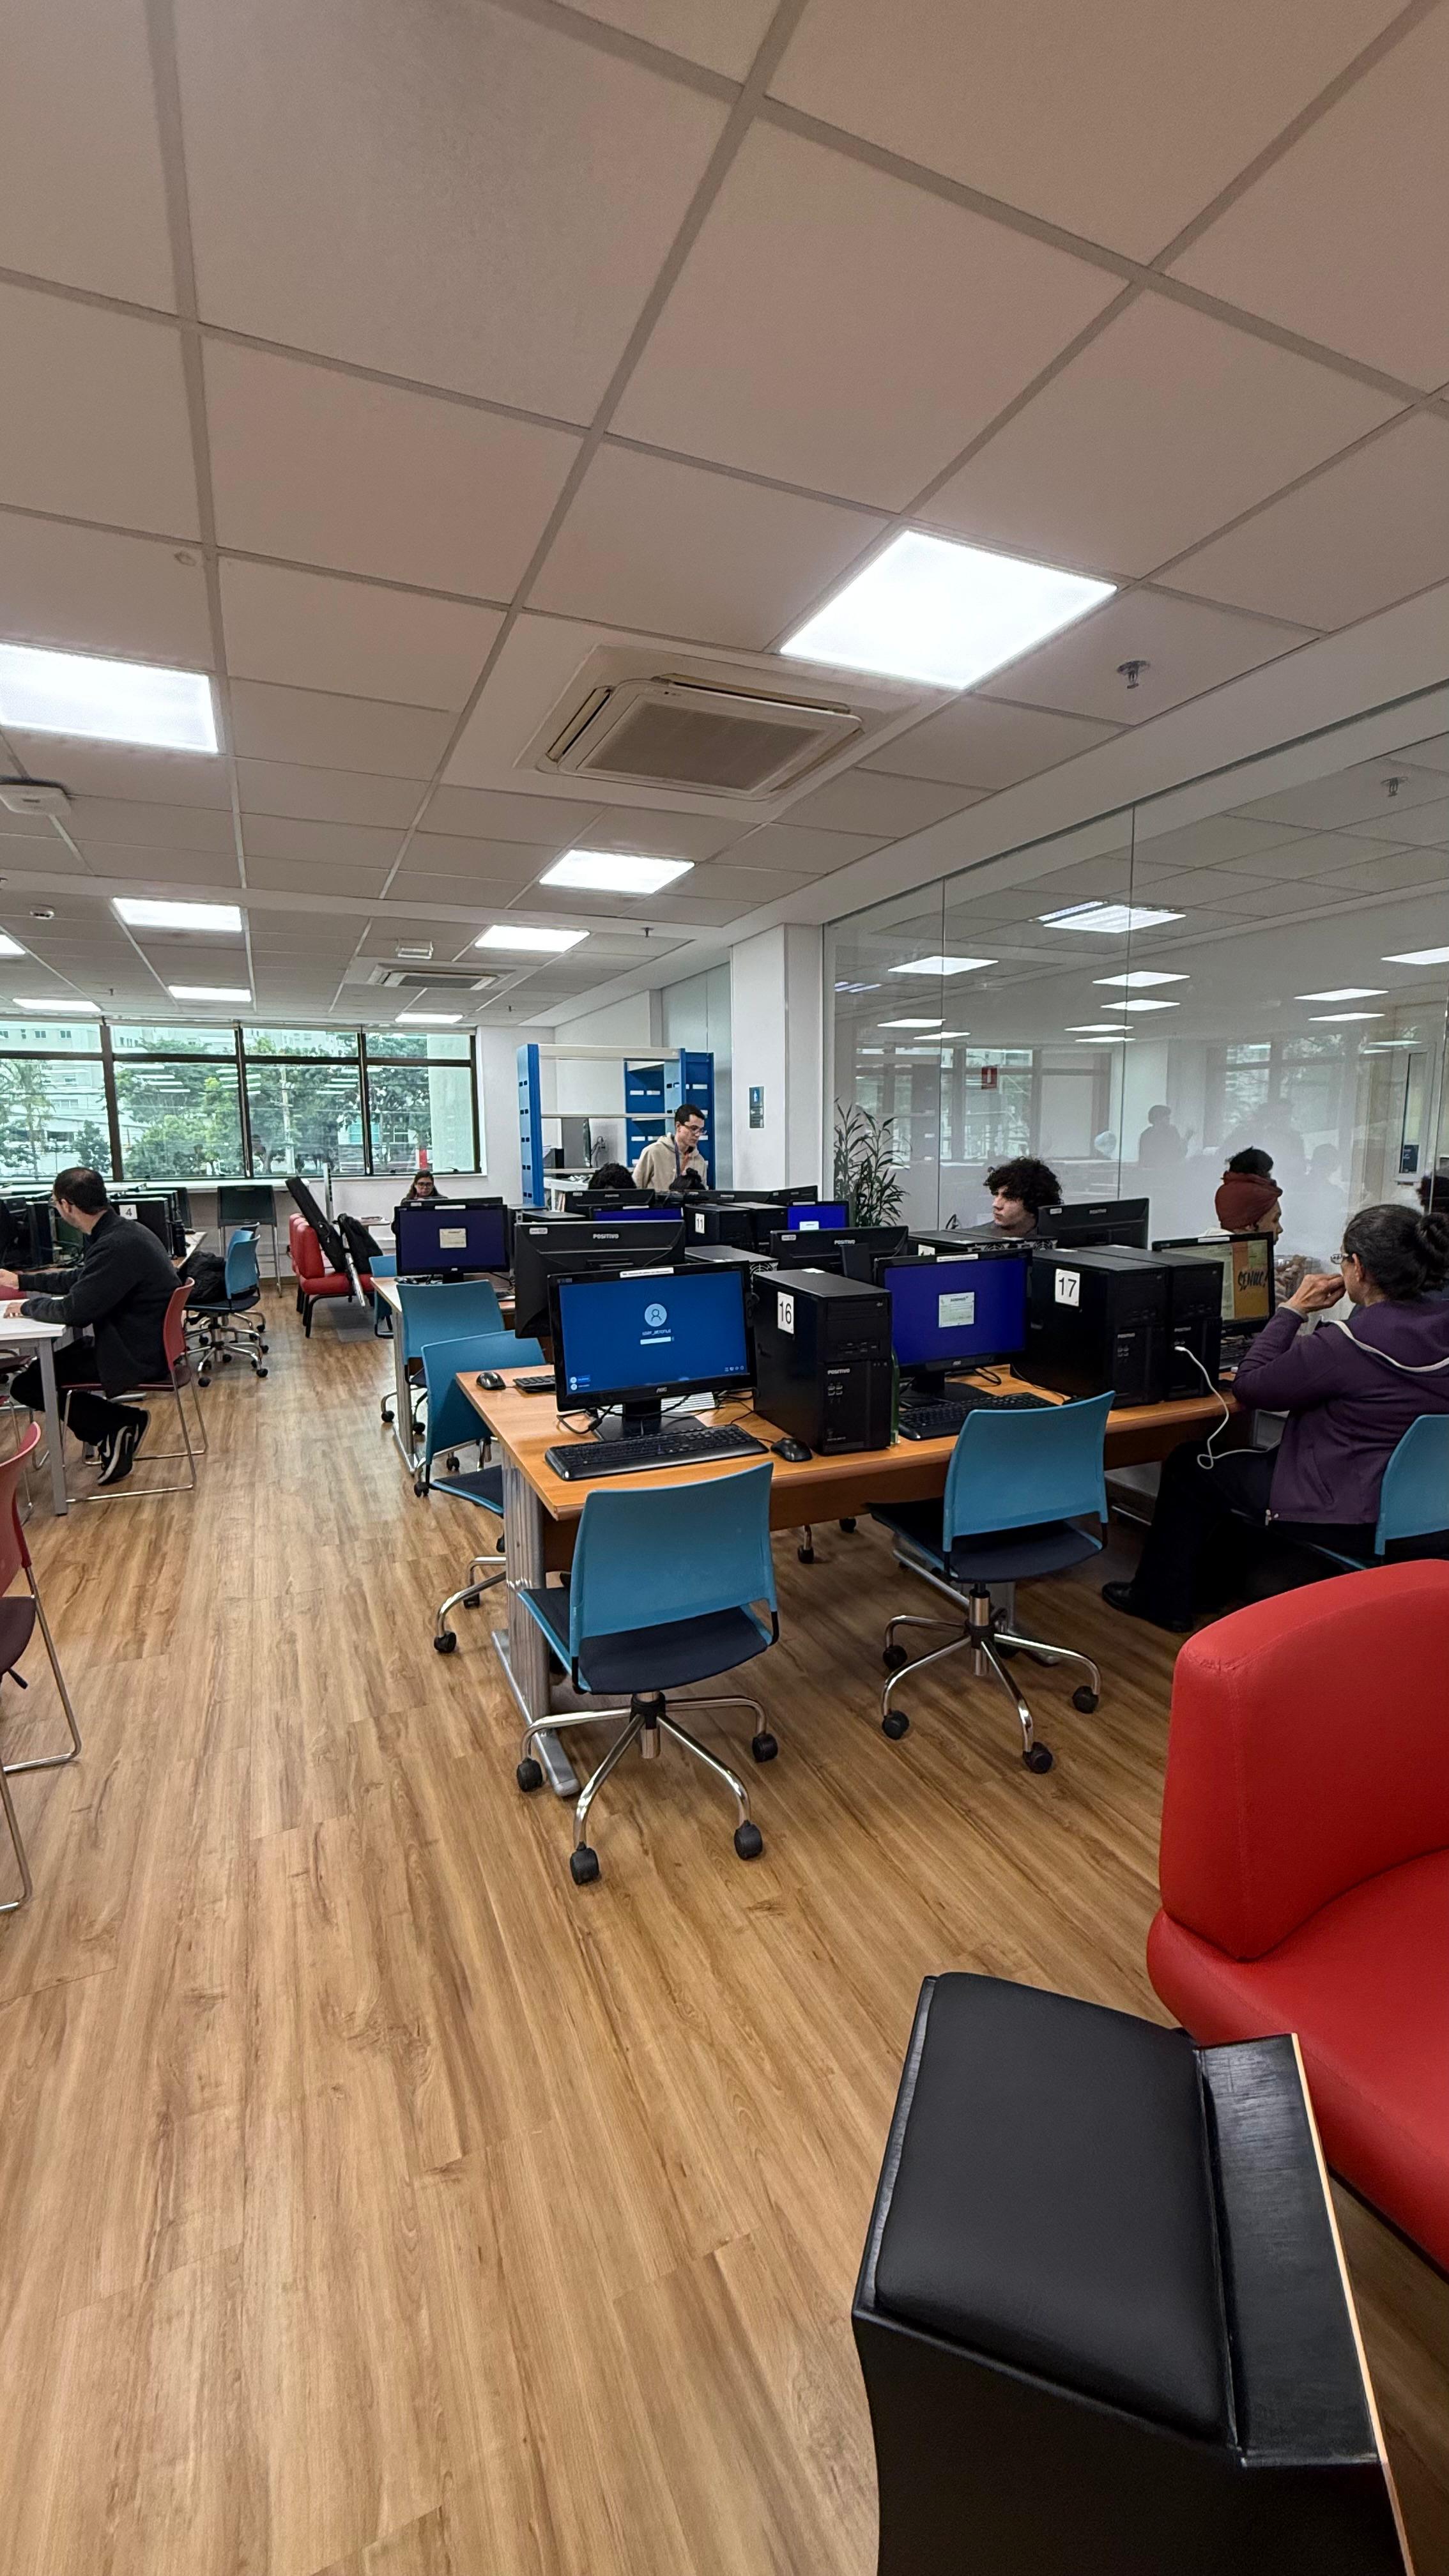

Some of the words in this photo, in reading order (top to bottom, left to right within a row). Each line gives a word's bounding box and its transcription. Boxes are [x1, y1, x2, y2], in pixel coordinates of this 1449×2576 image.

[125, 1208, 132, 1216] 4
[696, 1218, 703, 1229] 11
[1058, 1276, 1077, 1298] 17
[779, 1301, 792, 1324] 16
